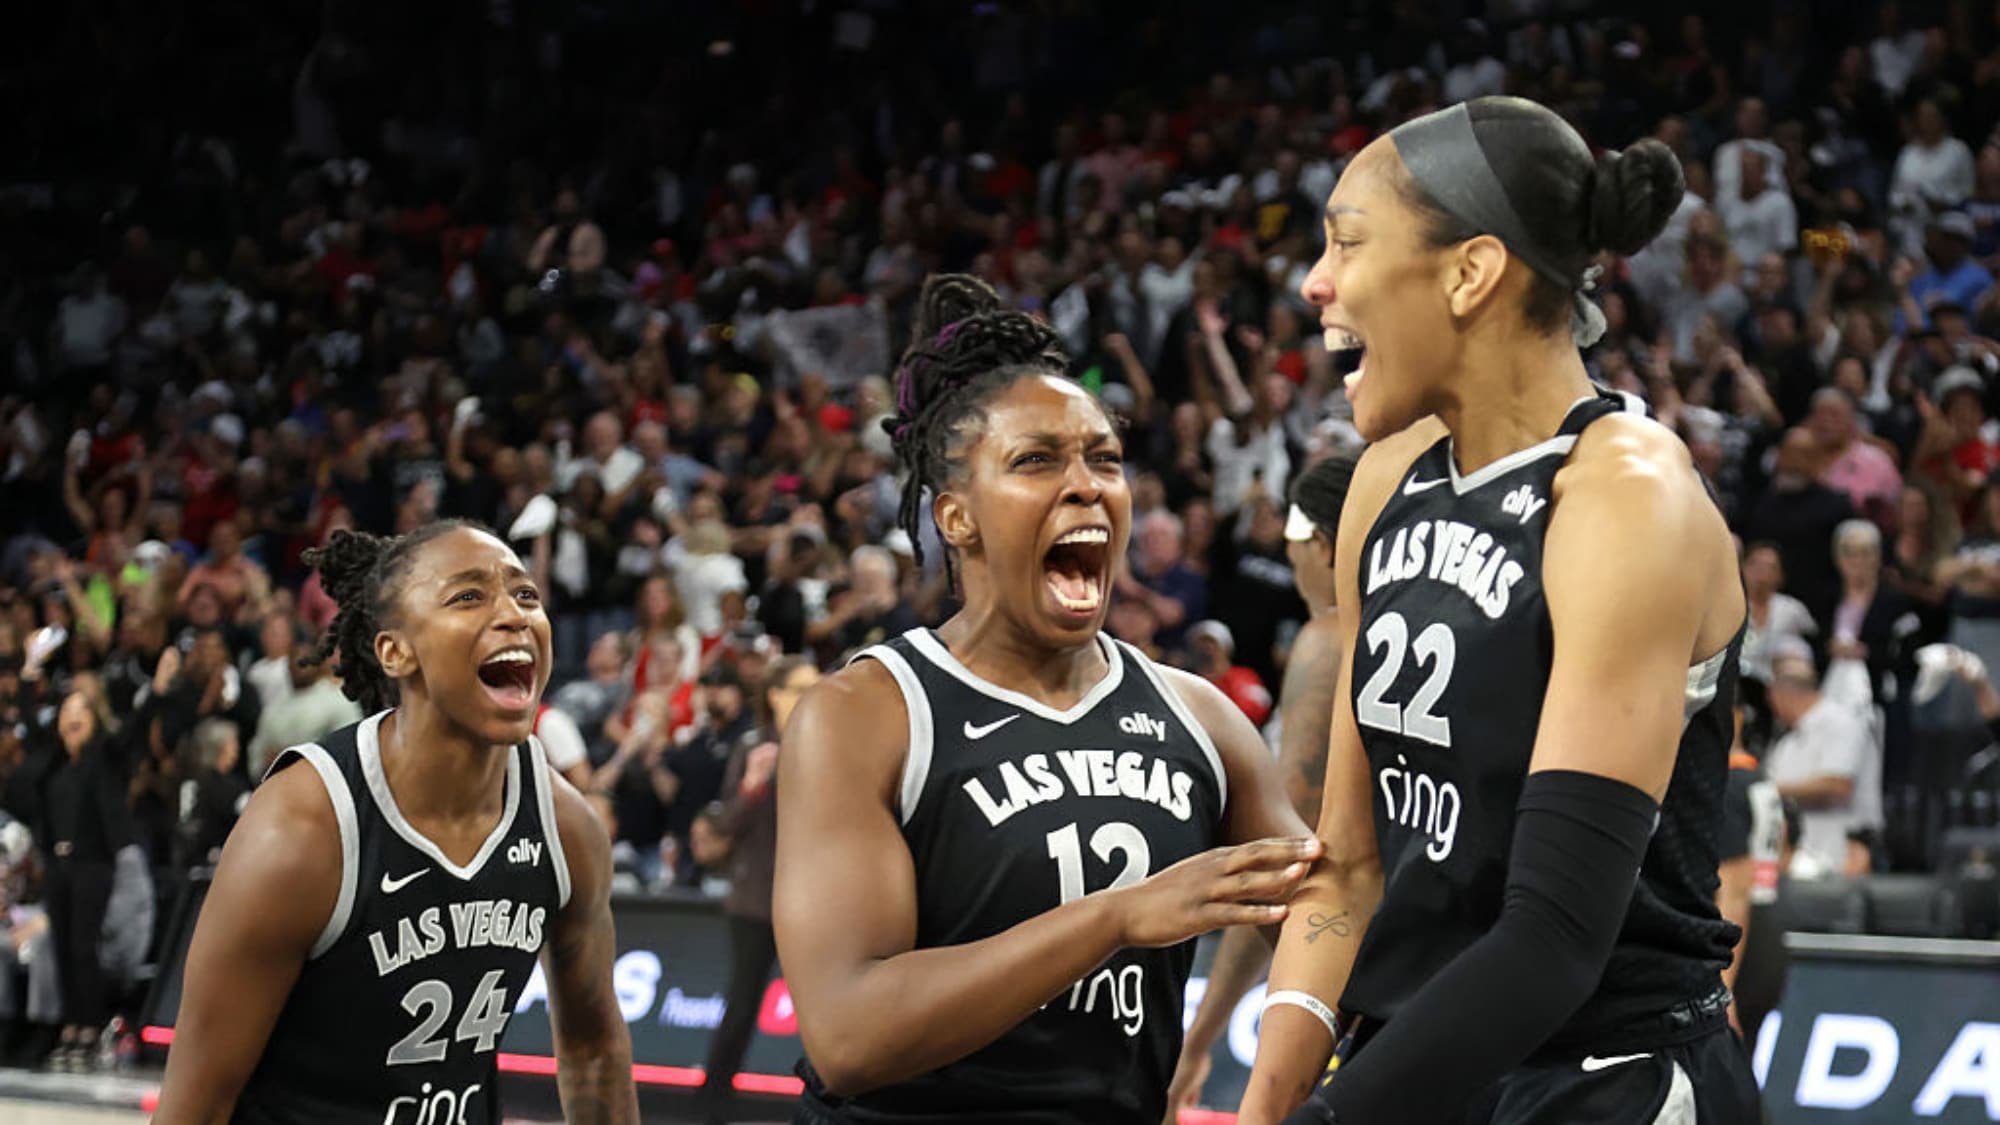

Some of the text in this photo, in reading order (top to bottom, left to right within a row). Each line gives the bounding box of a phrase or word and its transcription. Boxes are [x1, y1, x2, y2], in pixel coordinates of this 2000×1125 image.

[1502, 484, 1547, 525] ally
[1366, 520, 1433, 596] LAS
[1428, 519, 1525, 619] VEGAS
[1356, 611, 1456, 748] 22
[1118, 711, 1166, 742] ally
[962, 749, 1194, 827] LAS VEGAS
[1379, 753, 1461, 862] ring
[507, 837, 542, 867] ally
[1046, 821, 1151, 904] 12
[368, 898, 546, 977] LAS VEGAS
[386, 969, 510, 1066] 24
